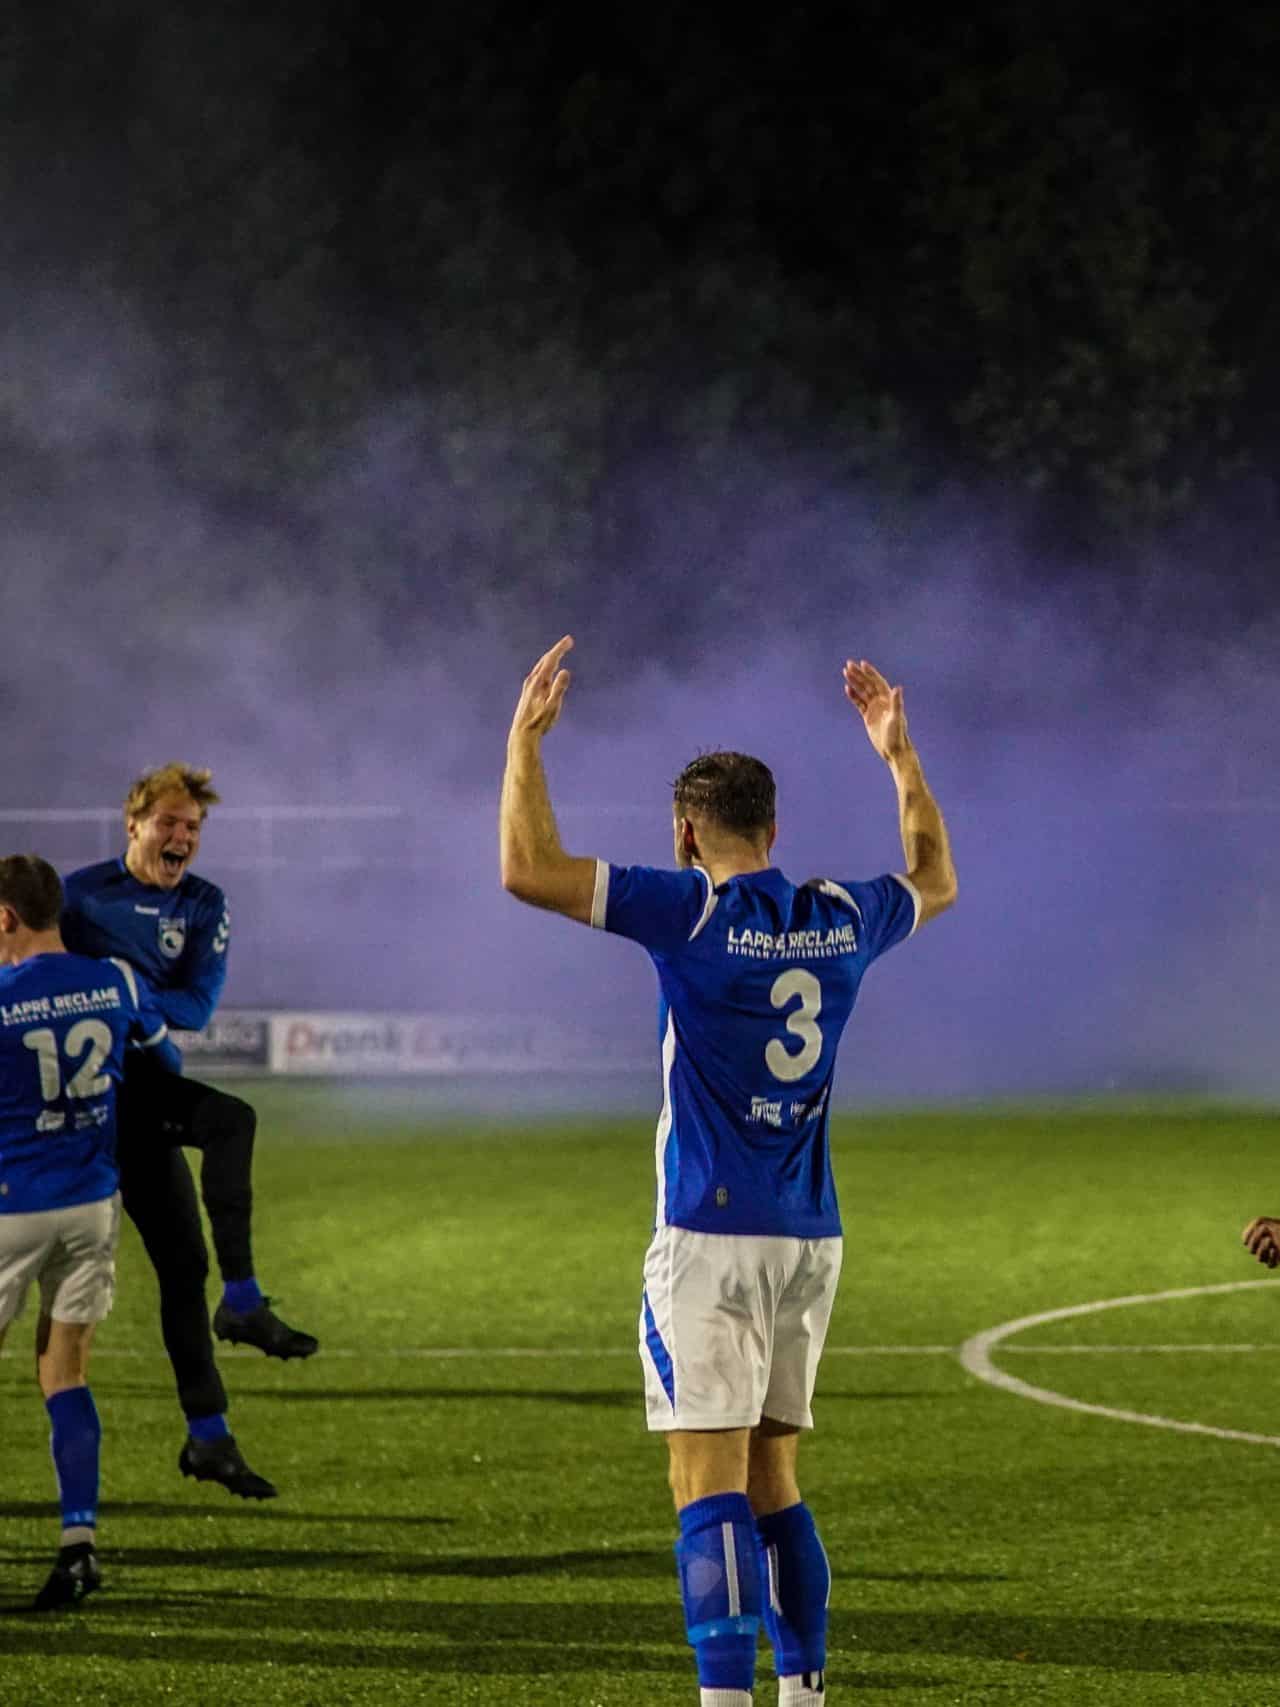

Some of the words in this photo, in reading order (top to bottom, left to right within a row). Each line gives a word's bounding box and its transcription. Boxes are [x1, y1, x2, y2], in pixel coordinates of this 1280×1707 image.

[788, 924, 855, 948] RECLAME
[53, 986, 119, 1009] RECLAME
[765, 968, 823, 1082] 3
[22, 1018, 112, 1102] 12
